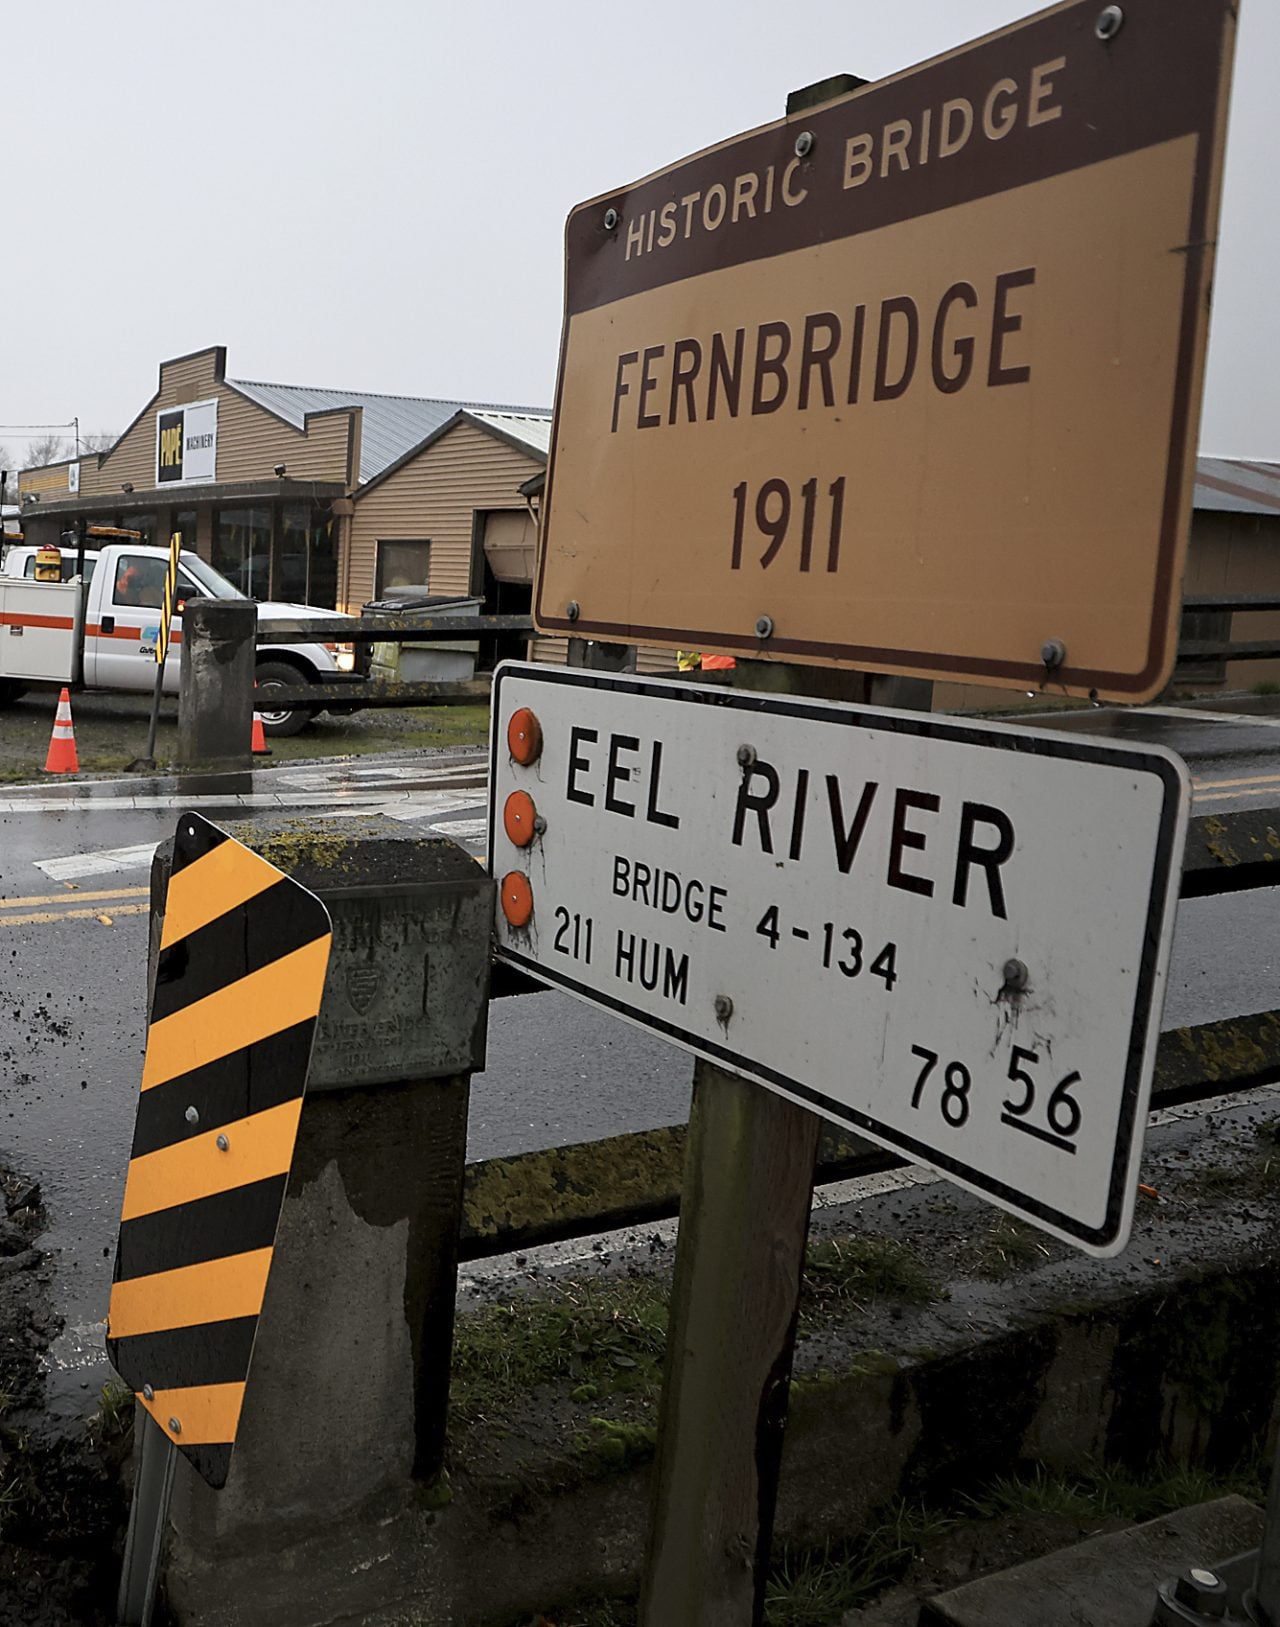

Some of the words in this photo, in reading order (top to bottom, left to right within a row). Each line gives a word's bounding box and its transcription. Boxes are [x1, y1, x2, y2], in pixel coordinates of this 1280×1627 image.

[624, 157, 809, 261] HISTORIC
[842, 56, 1067, 190] BRIDGE
[611, 267, 1036, 433] FERNBRIDGE
[731, 476, 847, 573] 1911
[566, 726, 680, 830] EEL
[732, 758, 1015, 920] RIVER
[554, 906, 593, 965] 211
[615, 929, 690, 1006] HUM
[613, 855, 728, 933] BRIDGE
[756, 905, 898, 992] 4-134
[911, 1044, 972, 1128] 78
[1002, 1044, 1082, 1137] 56
